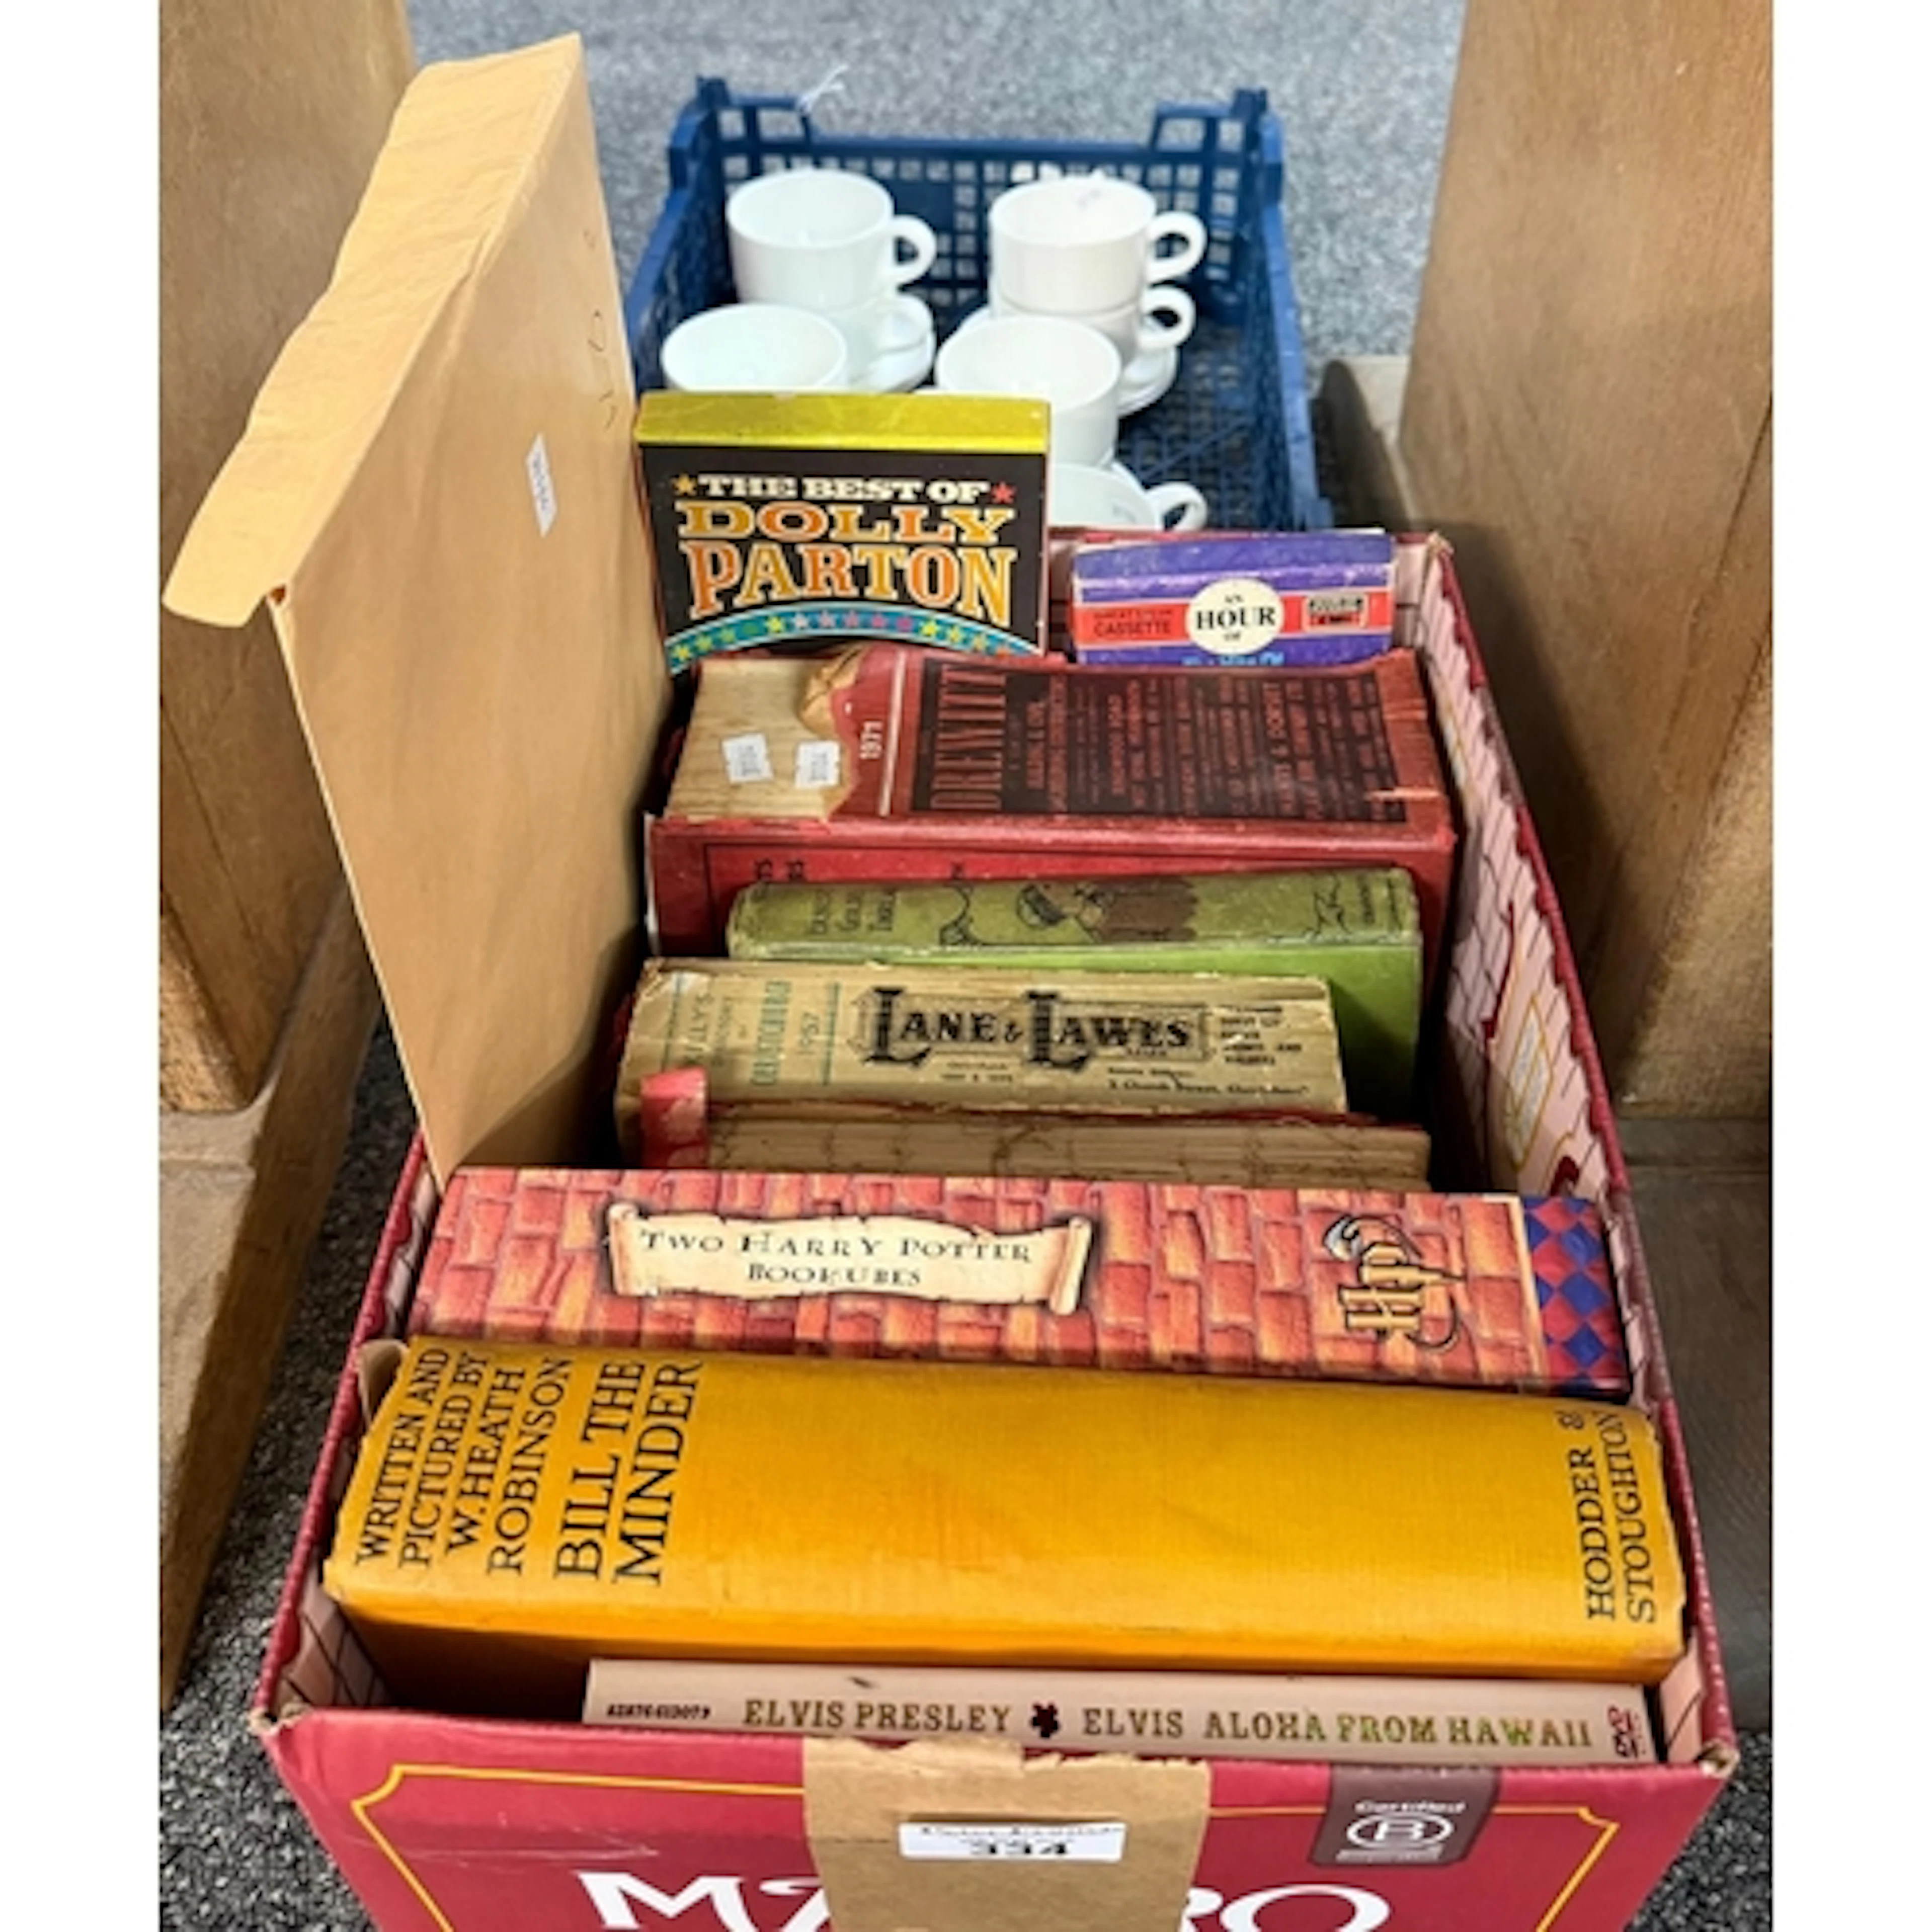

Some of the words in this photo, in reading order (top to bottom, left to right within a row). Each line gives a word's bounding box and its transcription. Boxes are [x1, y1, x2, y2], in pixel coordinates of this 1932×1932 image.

[675, 500, 1015, 545] DOLLY
[698, 473, 798, 498] THE
[801, 475, 925, 501] BEST
[926, 480, 990, 503] OF
[679, 539, 1018, 628] PARTON
[1196, 606, 1276, 630] HOUR
[640, 1229, 723, 1252] TWO
[741, 1230, 882, 1257] HARRY
[901, 1237, 1032, 1262] POTTER
[581, 1361, 646, 1444] THE
[1556, 1410, 1585, 1430] &
[355, 1413, 423, 1565] WRITTEN
[407, 1348, 449, 1407] AND
[398, 1395, 472, 1569] PICTURED
[453, 1352, 489, 1388] BY
[486, 1357, 573, 1576] ROBINSON
[612, 1360, 703, 1586] MINDER
[553, 1454, 620, 1580] BILL
[1568, 1447, 1615, 1623] HODDER
[1593, 1410, 1656, 1624] STOUGHTON
[742, 1700, 845, 1728] ELVIS
[853, 1701, 1010, 1733] PRESLEY
[1083, 1708, 1184, 1738] ELVIS
[1202, 1710, 1327, 1743] ALOHA
[1336, 1714, 1439, 1745] FROM
[1447, 1717, 1593, 1748] HAWAII
